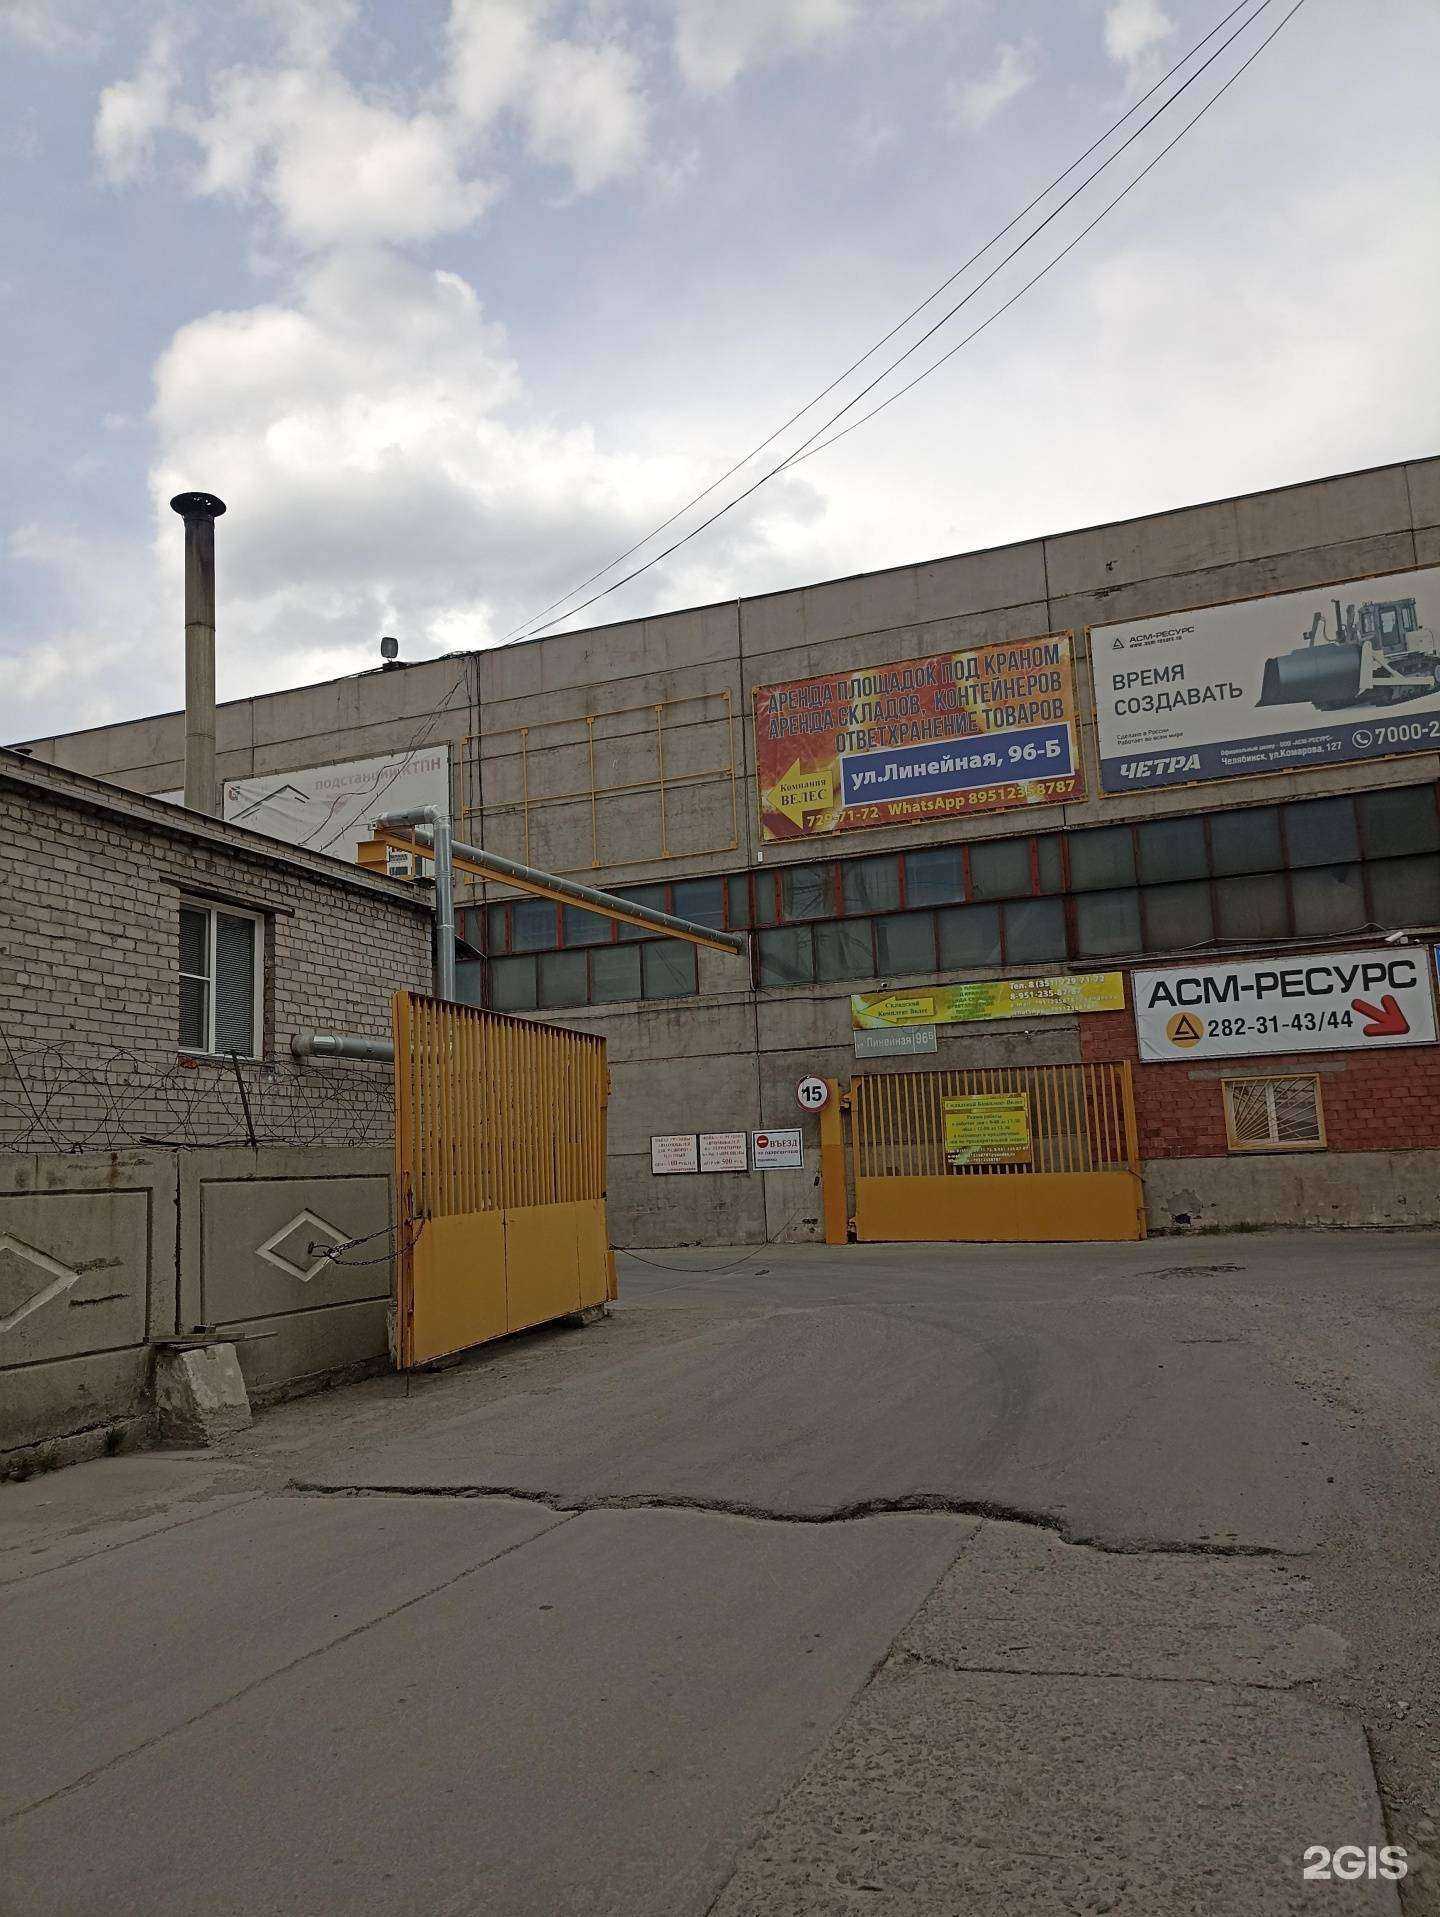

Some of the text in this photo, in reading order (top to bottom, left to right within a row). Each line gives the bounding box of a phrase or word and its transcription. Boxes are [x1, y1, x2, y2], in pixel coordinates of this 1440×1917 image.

[1129, 626, 1195, 643] АСМ-РЕСУРС
[768, 644, 1060, 714] АРЕНДА ПЛОЩАДОК ПОД КРАНОМ
[1112, 664, 1185, 690] ВРЕМЯ
[768, 709, 833, 740] АРЕНДА
[934, 671, 1062, 709] КОНТЕЙНЕРОВ
[1114, 682, 1243, 716] СОЗДАВАТЬ
[835, 698, 1064, 752] ОТВЕТХРАНЕНИЕ ТОВАРОВ
[1326, 741, 1343, 751] 127
[851, 739, 1061, 791] ул.Линейная, 96-Б
[1120, 753, 1201, 780] ЧЕТРА
[780, 779, 826, 792] Компания
[781, 789, 827, 806] ВЕЛЕС
[888, 796, 965, 816] WhatsApp
[1148, 959, 1417, 1008] АСМ-РЕСУРС
[1208, 1010, 1353, 1037] 282-31-43/44
[867, 1036, 912, 1049] Линейная
[801, 1085, 822, 1102] 15
[770, 1139, 797, 1147] ВЪЕЗД
